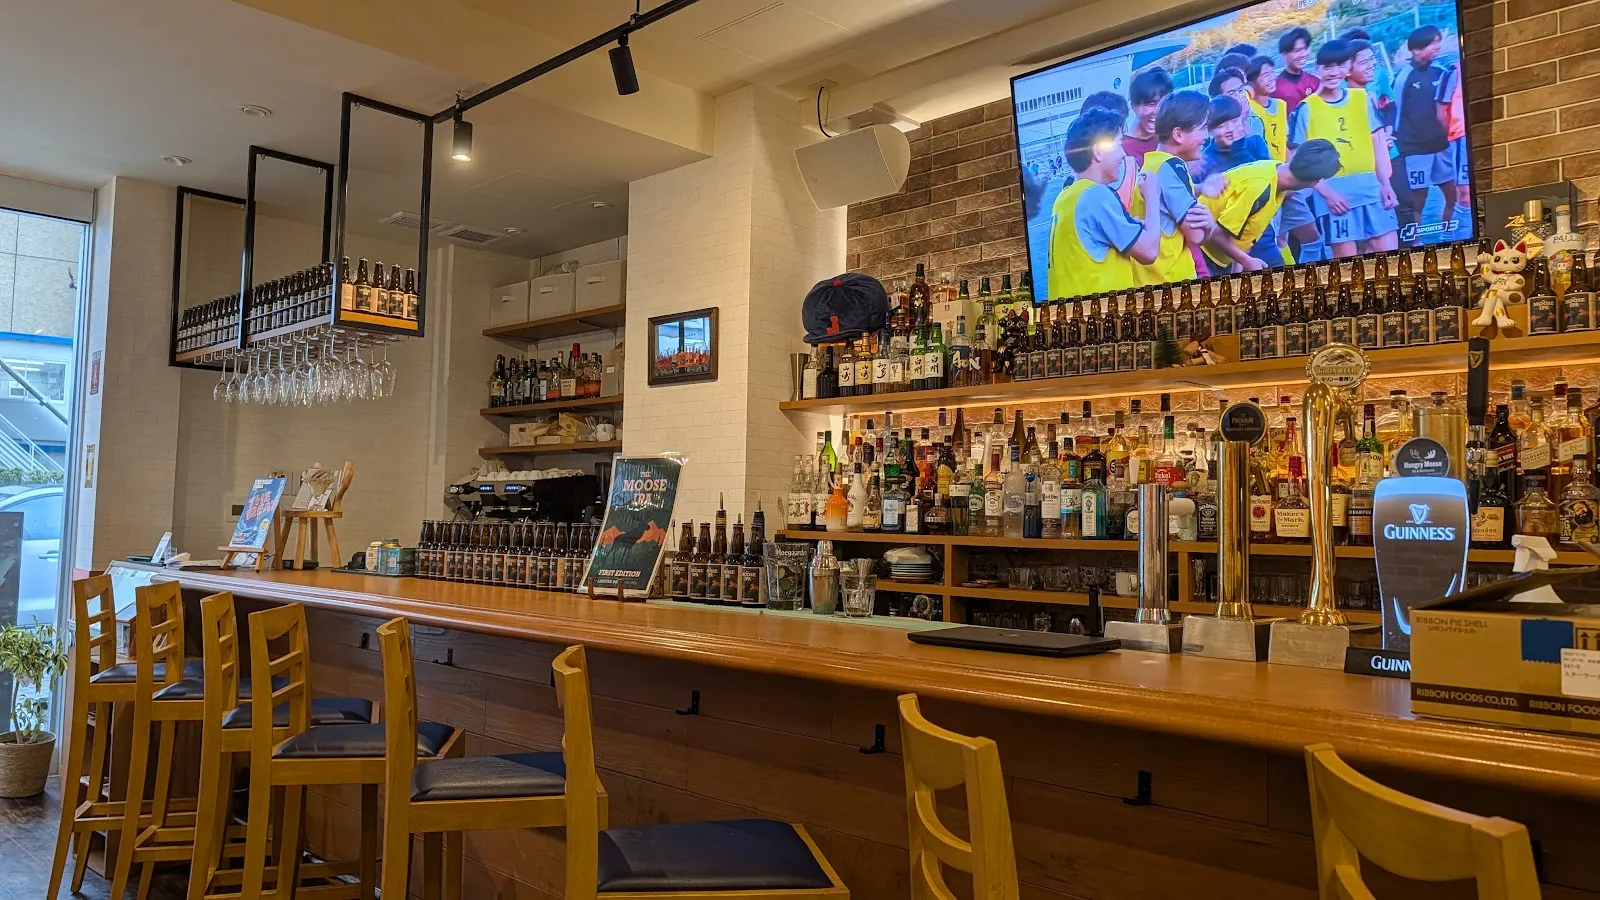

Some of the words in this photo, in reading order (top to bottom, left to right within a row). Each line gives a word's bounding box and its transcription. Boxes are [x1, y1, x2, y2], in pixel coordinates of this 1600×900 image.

[1271, 124, 1276, 136] 7
[1338, 117, 1348, 131] 2
[1410, 171, 1425, 185] 50
[1333, 219, 1349, 238] 14
[1417, 224, 1444, 233] SPORTS
[1448, 220, 1459, 231] 3
[623, 479, 668, 491] MOOSE
[632, 493, 652, 506] IPA
[1384, 524, 1455, 541] GUINNESS
[1416, 616, 1448, 625] RIBBON
[1450, 619, 1462, 627] PIE
[1464, 619, 1488, 628] SHELL
[1416, 688, 1449, 699] RIBBON
[1450, 692, 1483, 702] FOODS
[1529, 700, 1566, 712] RIBBON
[1567, 704, 1600, 715] FOODS
